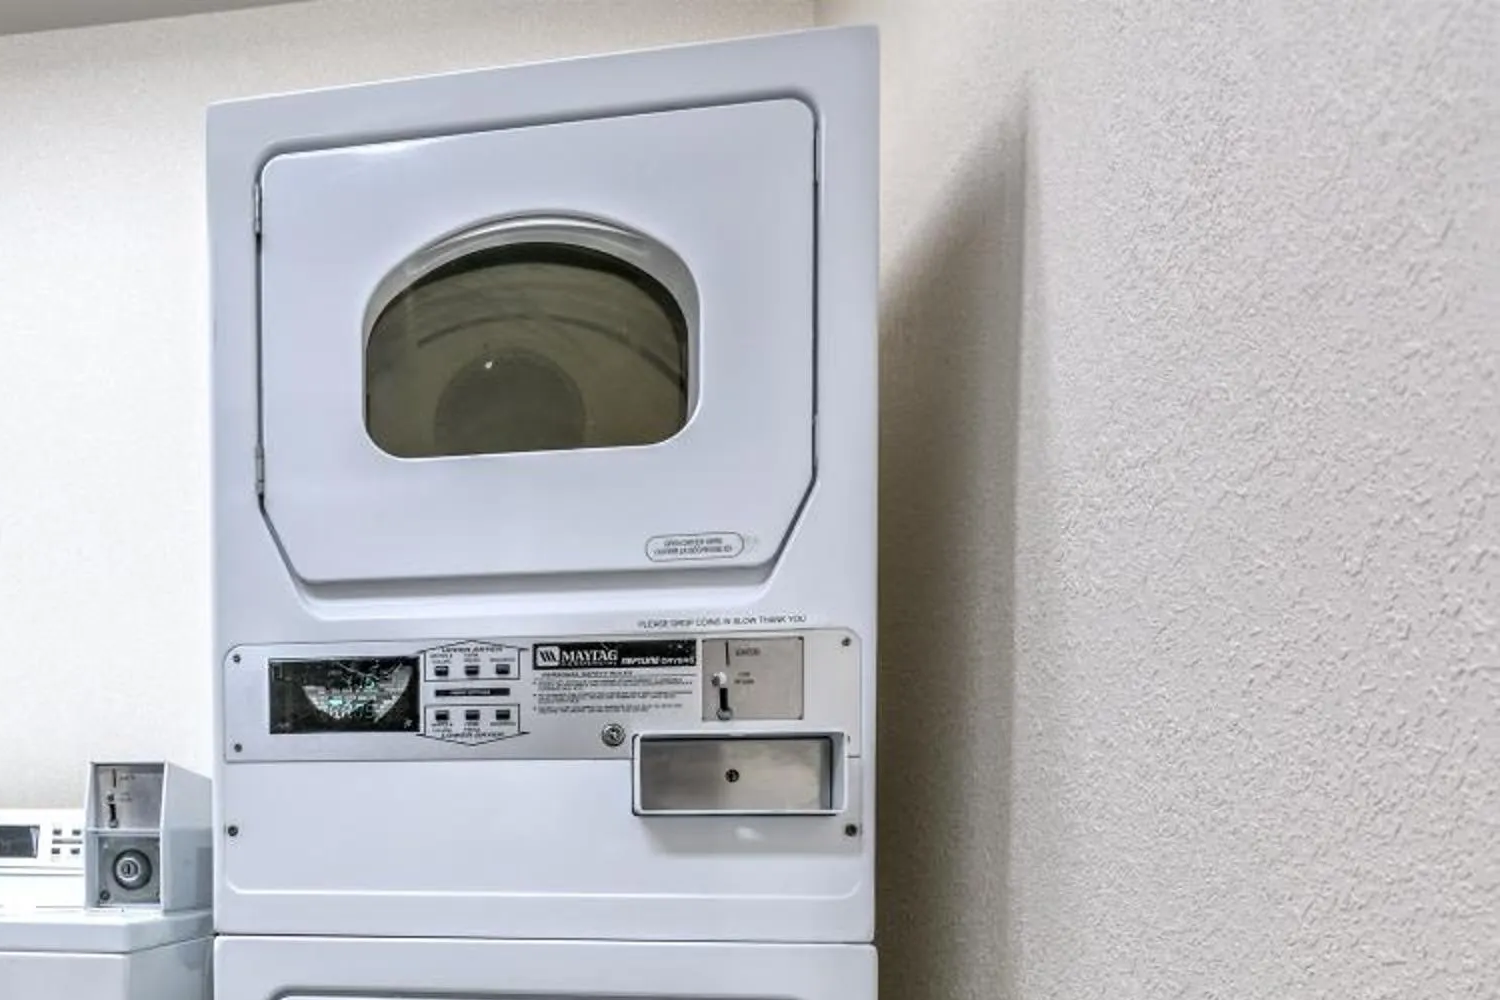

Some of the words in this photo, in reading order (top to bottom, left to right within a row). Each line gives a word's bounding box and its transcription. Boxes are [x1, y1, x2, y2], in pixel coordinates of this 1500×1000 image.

[759, 616, 786, 625] THANK
[787, 615, 807, 623] YOU
[562, 649, 618, 661] MAYTAG
